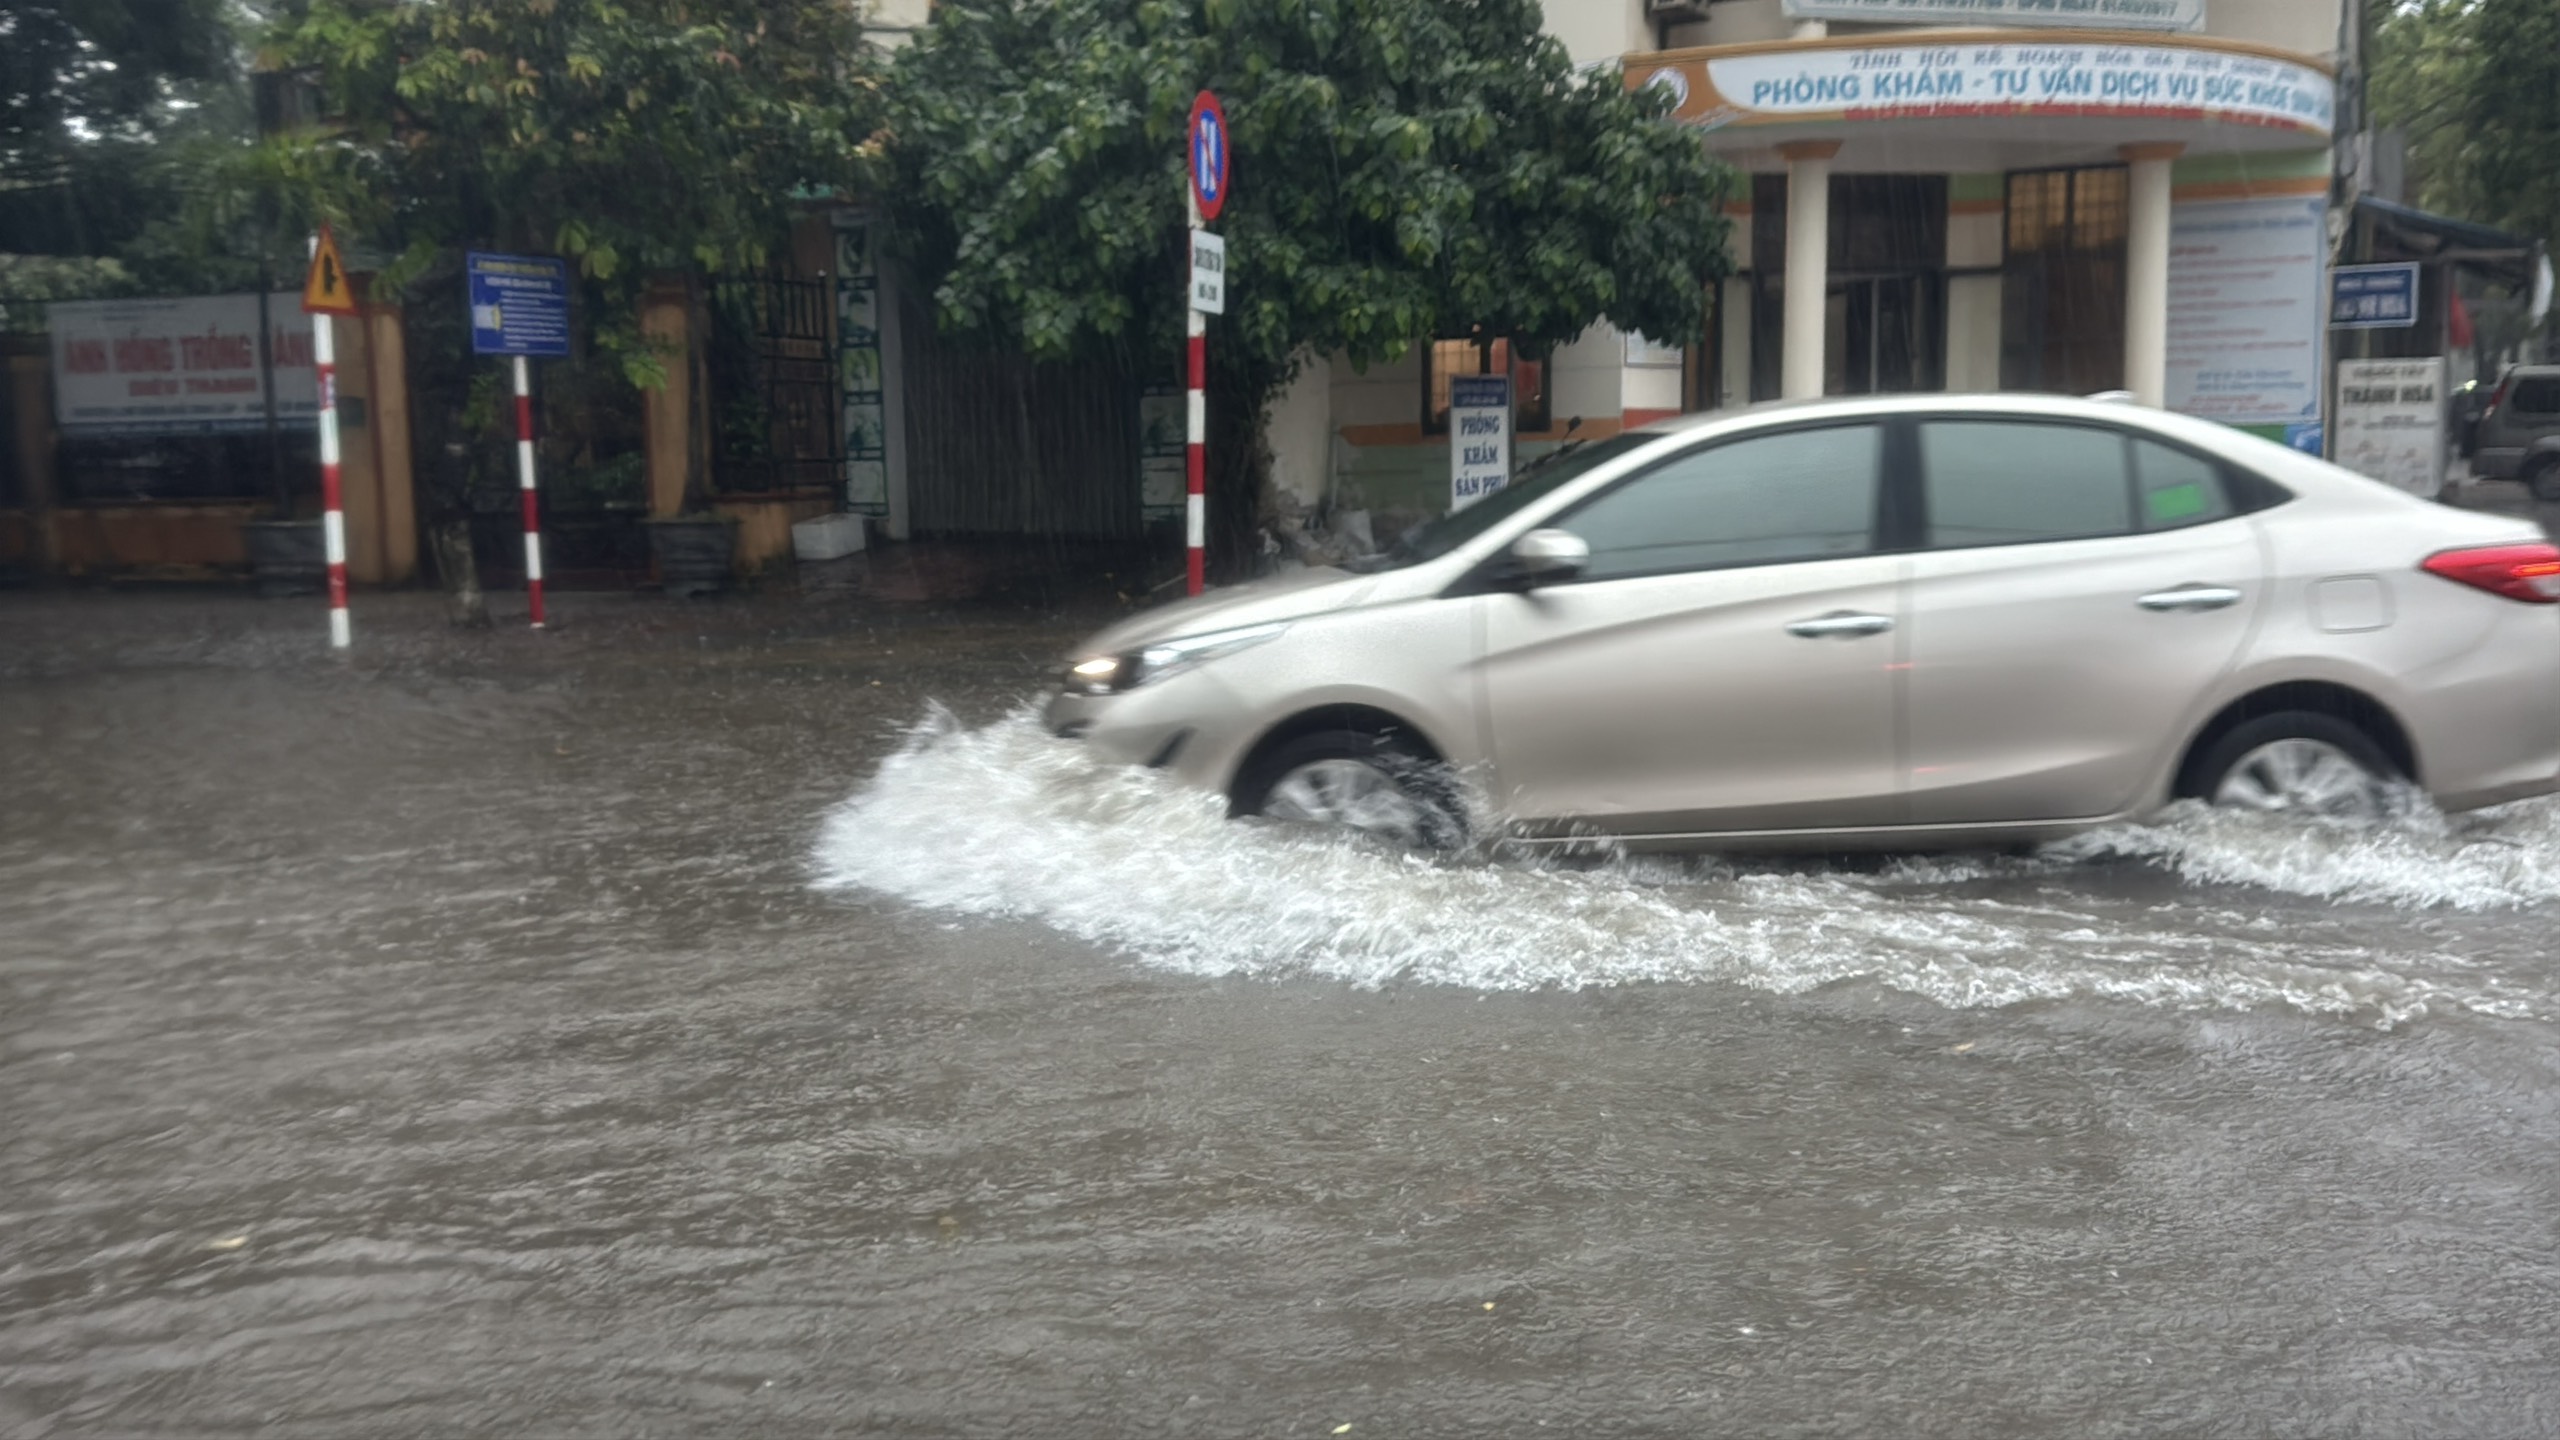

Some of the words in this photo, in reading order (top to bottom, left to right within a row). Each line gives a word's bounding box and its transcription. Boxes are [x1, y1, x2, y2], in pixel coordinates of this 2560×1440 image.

[1753, 70, 1861, 104] PHÒNG
[1872, 67, 1964, 98] KHÁM
[1989, 67, 2030, 94] TƯ
[2039, 63, 2093, 96] VẤN
[2101, 69, 2160, 102] DỊCH
[1463, 442, 1498, 465] KHÁM
